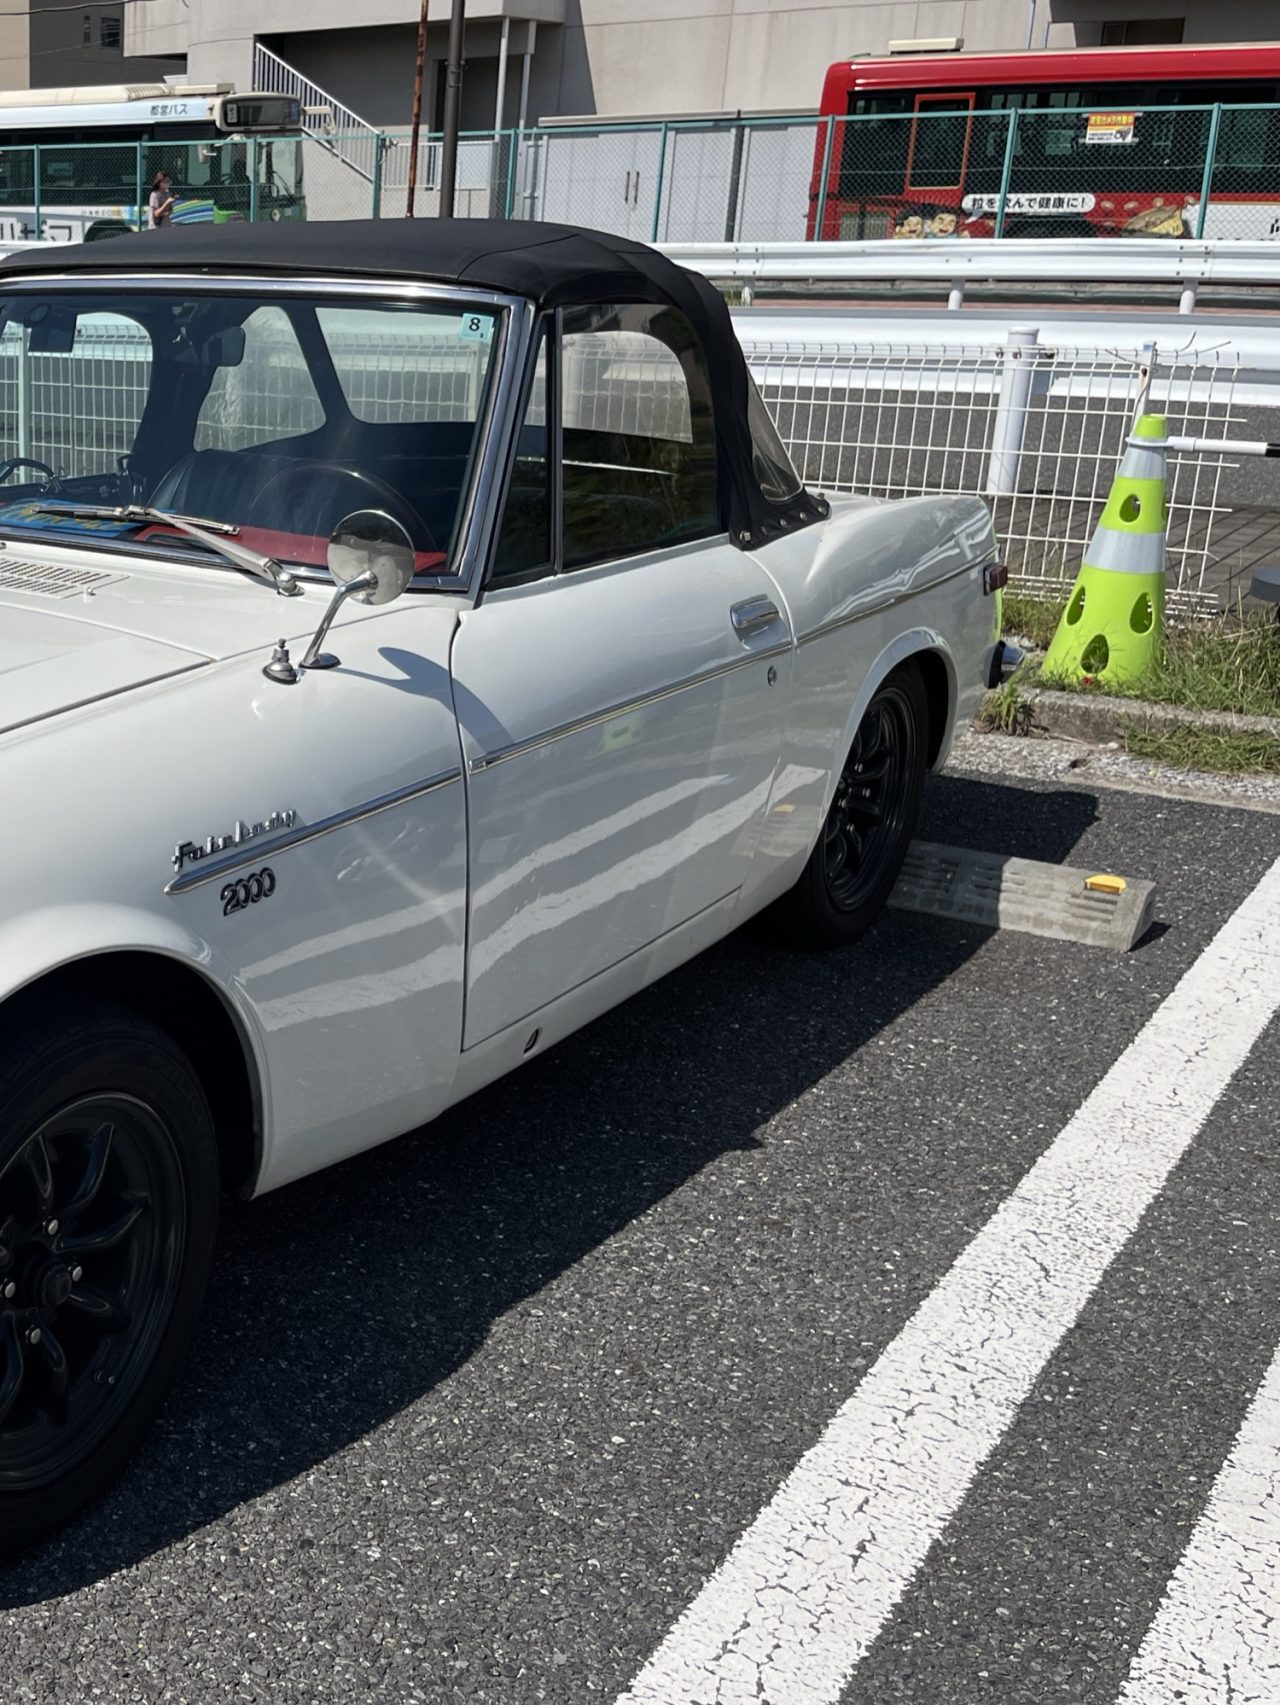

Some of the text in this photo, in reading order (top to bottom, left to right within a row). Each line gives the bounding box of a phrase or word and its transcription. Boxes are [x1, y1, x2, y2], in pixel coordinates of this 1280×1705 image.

[150, 104, 188, 116] 都営バス
[469, 317, 481, 332] 8
[220, 867, 276, 917] 2000
